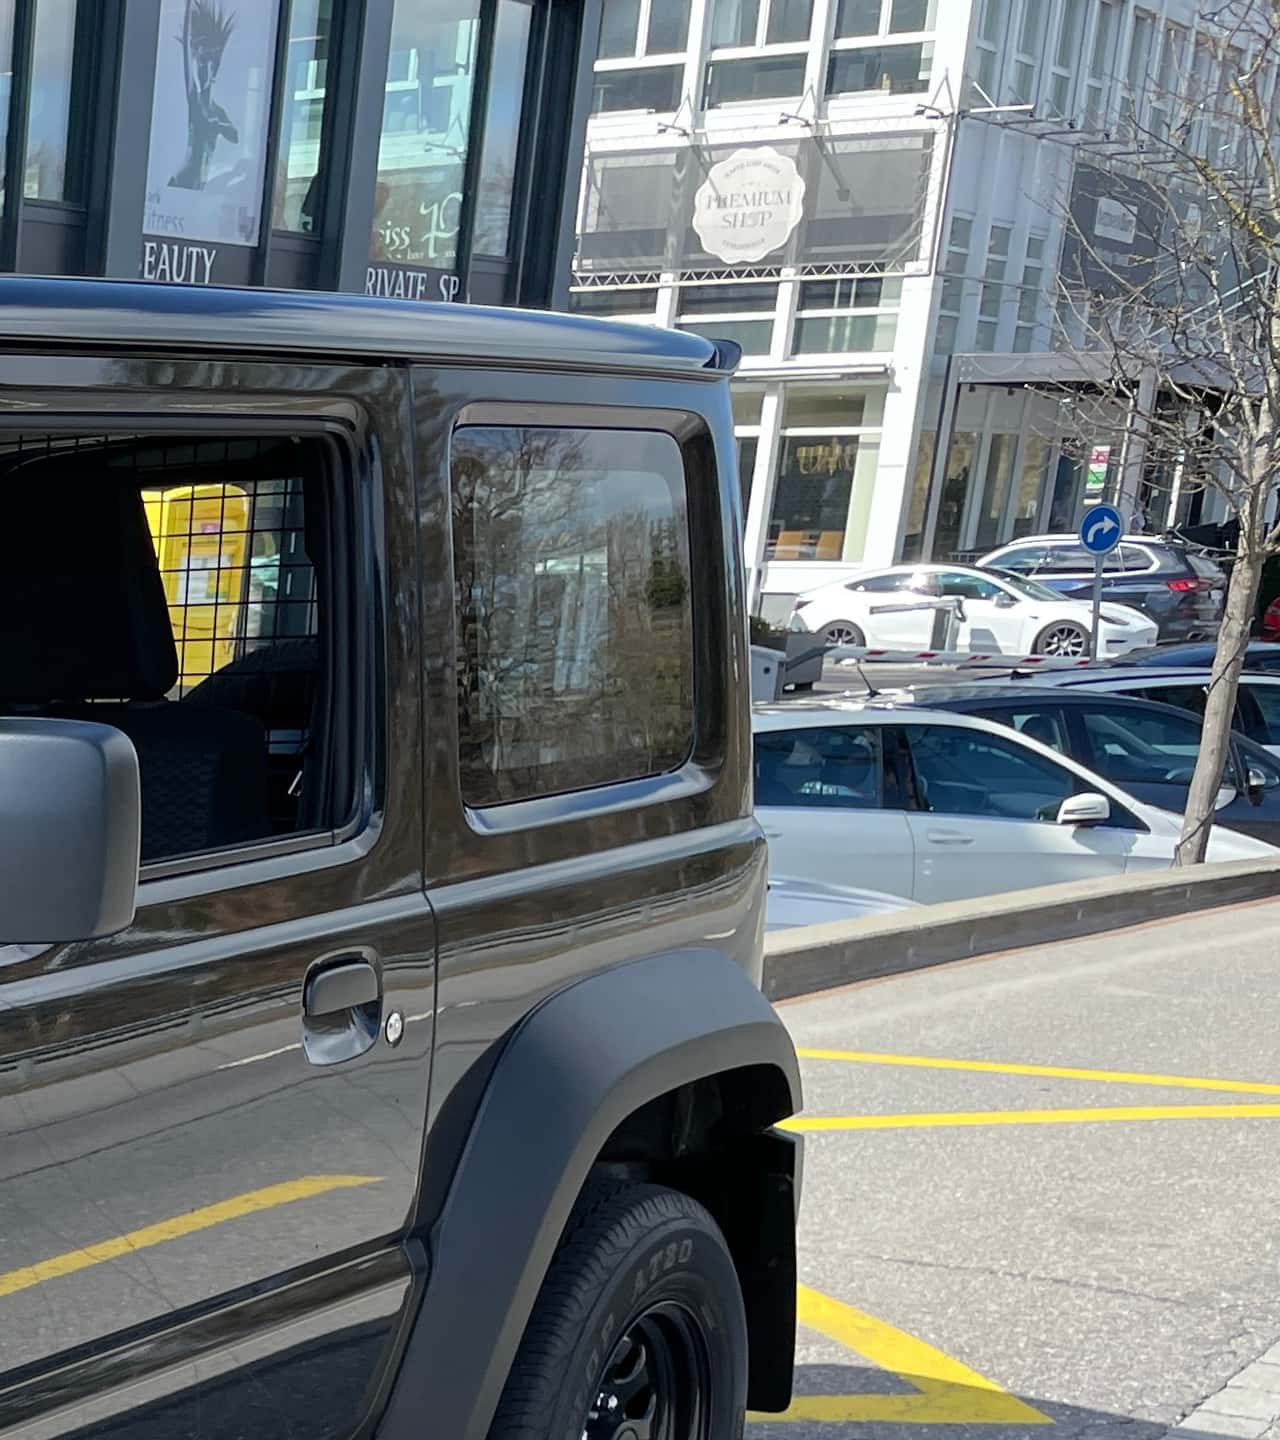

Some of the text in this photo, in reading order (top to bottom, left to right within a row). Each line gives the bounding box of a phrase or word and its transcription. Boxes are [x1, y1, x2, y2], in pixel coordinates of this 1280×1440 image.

[705, 189, 793, 210] PREMIUM
[722, 210, 773, 229] SHOP
[138, 241, 217, 285] EAUTY
